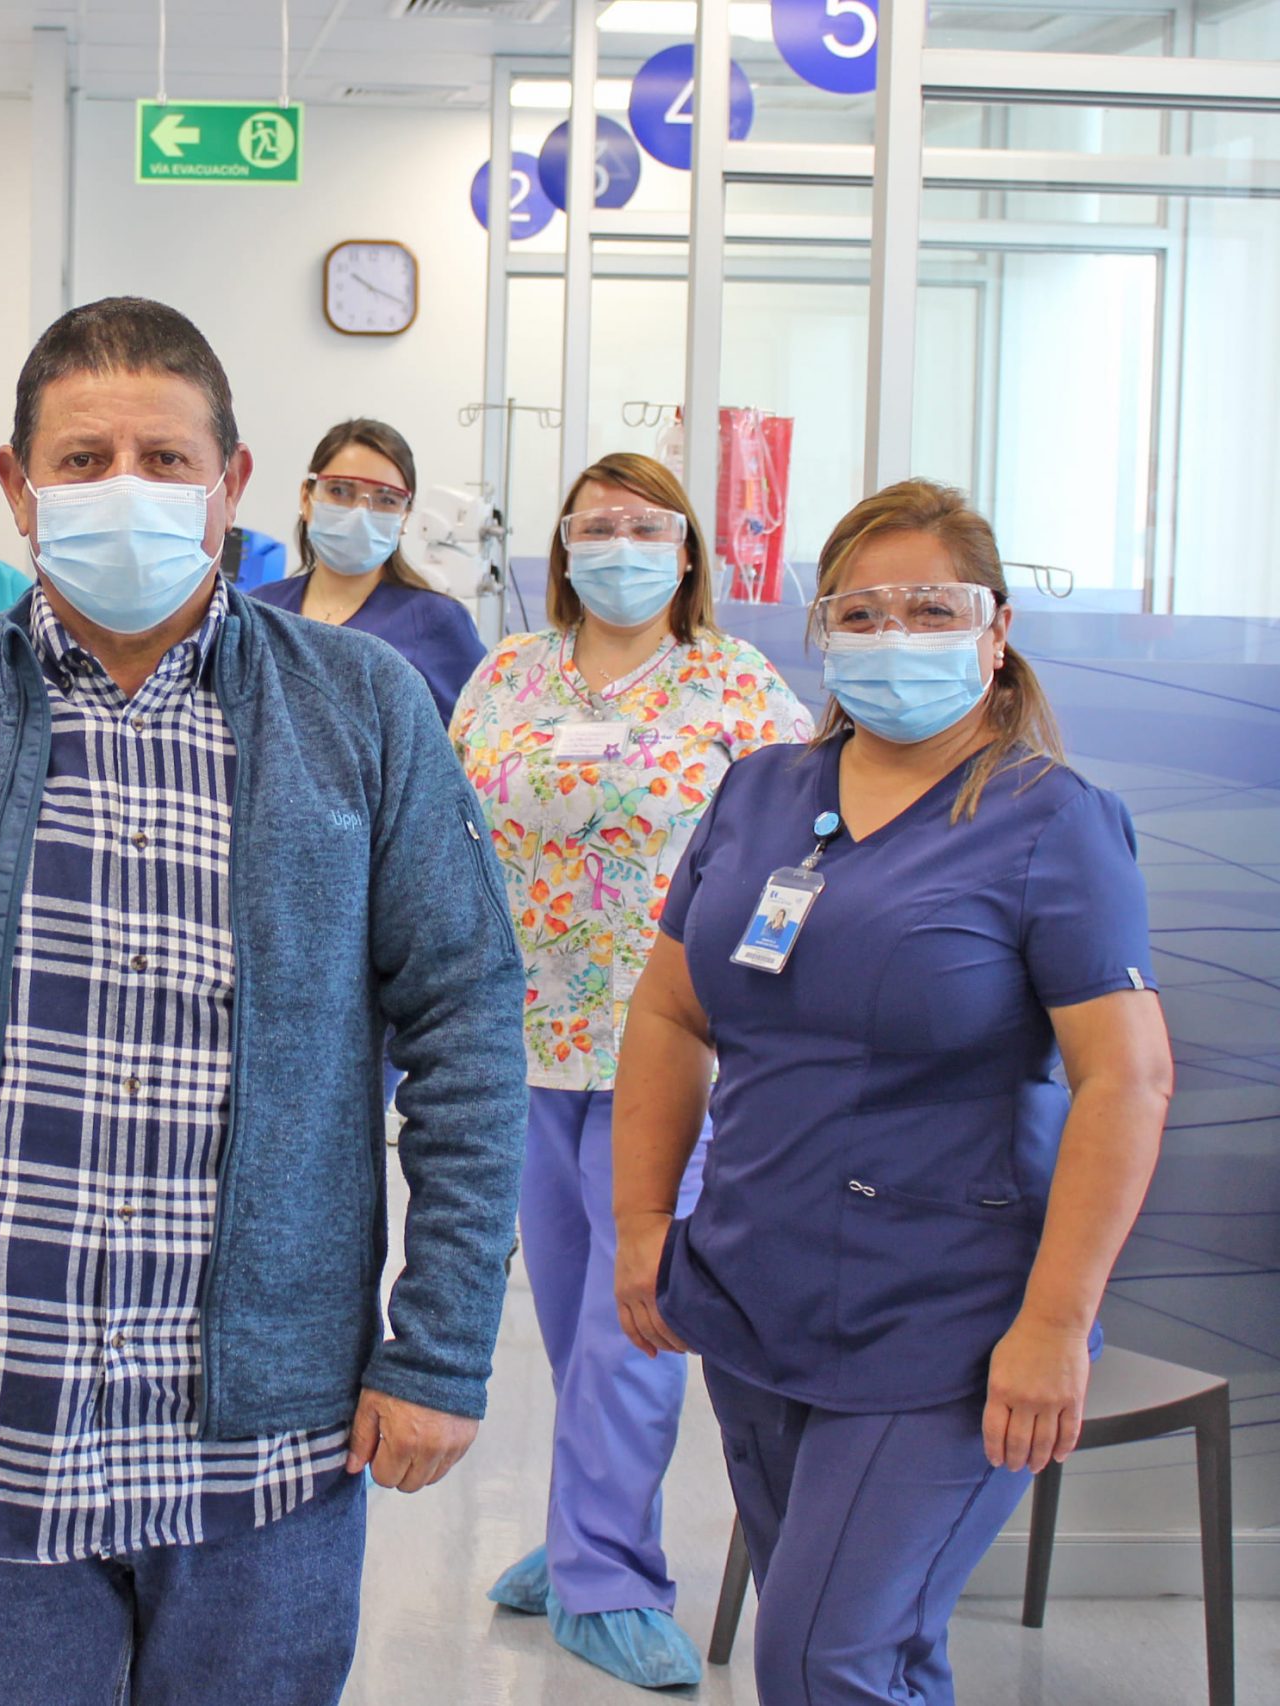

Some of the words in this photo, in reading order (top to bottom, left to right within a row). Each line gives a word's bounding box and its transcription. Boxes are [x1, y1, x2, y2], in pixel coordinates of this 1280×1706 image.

[822, 0, 878, 59] 5
[149, 162, 170, 175] VÍA
[172, 163, 250, 176] EVACUACIÓN
[509, 169, 532, 222] 2
